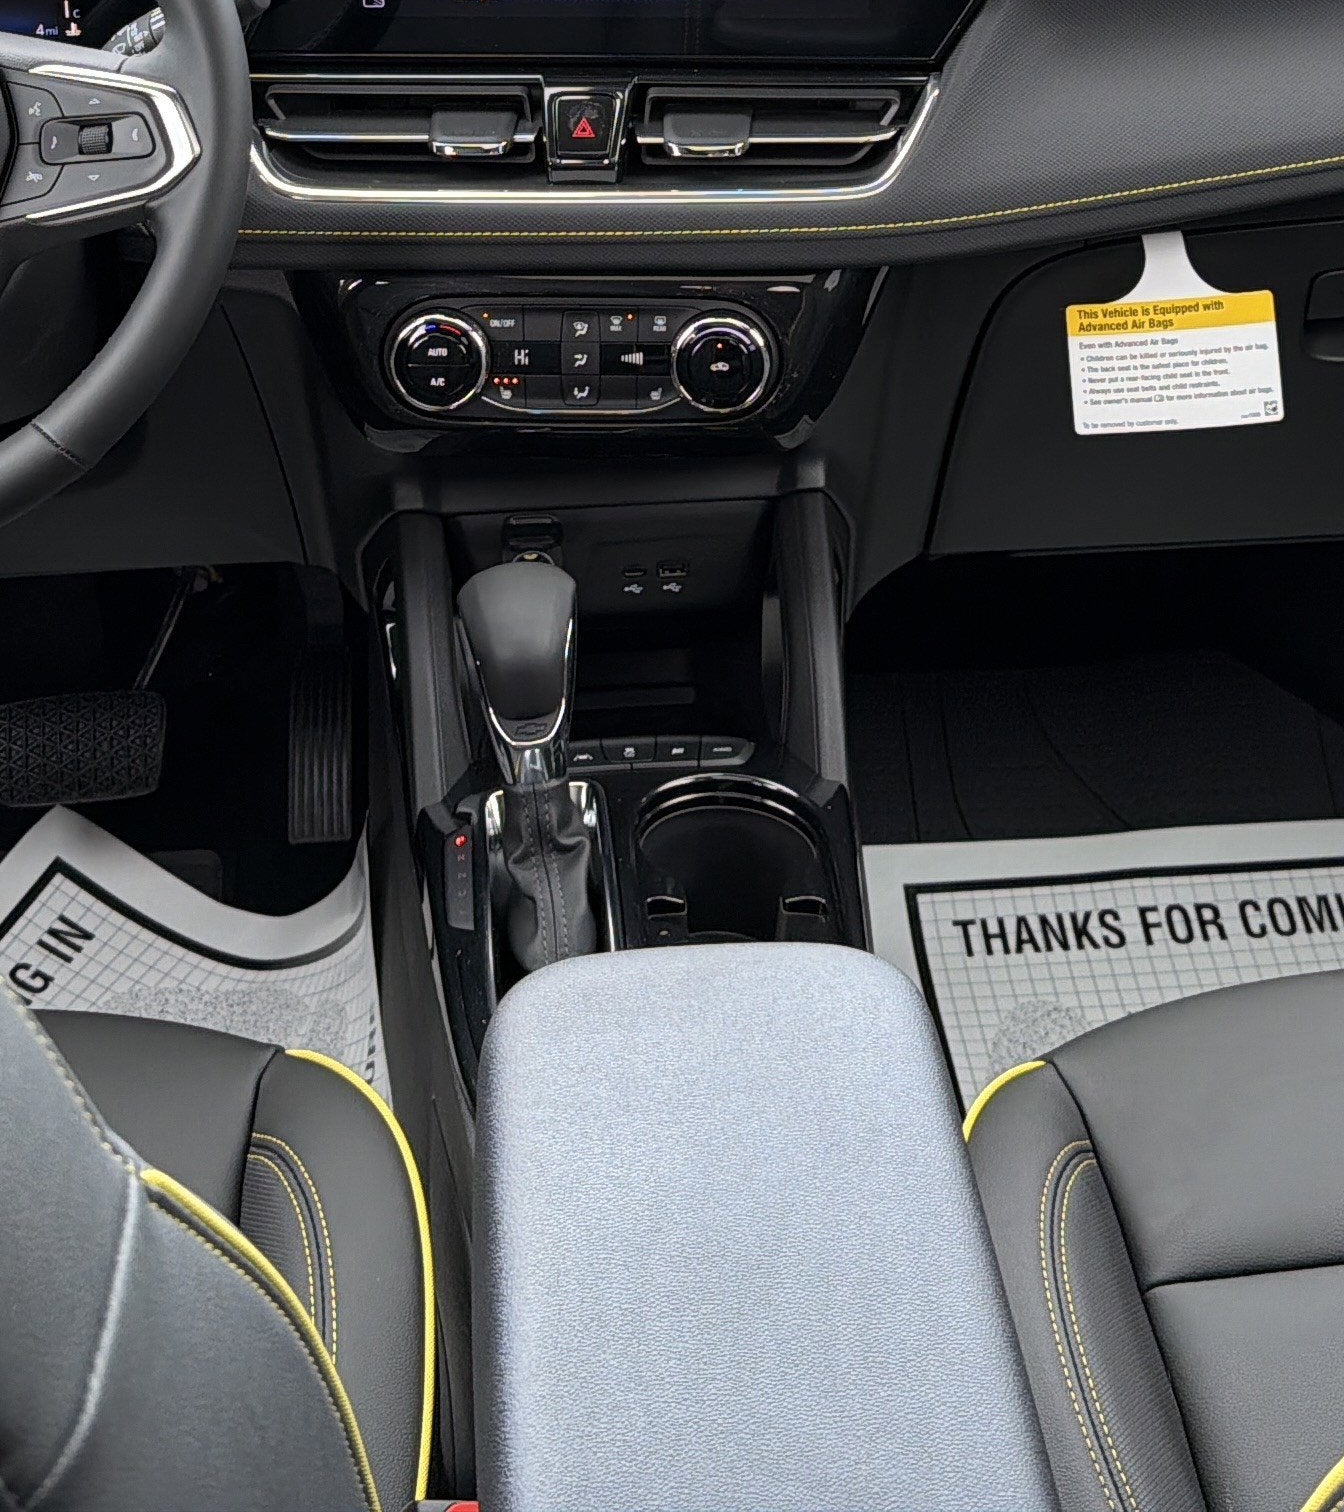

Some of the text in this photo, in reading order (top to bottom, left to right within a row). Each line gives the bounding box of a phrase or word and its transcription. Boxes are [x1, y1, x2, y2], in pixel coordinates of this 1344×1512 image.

[73, 9, 81, 18] C
[36, 23, 59, 36] 4 mi
[1077, 300, 1224, 320] This Vehicle is Equipped with
[489, 319, 515, 327] ON/OFF
[1078, 318, 1174, 332] Advanced Air Bags
[1079, 342, 1096, 350] Even
[1114, 339, 1148, 347] Advanced
[427, 348, 448, 357] AUTO
[514, 349, 529, 365] Hi
[430, 378, 446, 386] A/C
[952, 909, 1127, 959] THANKS
[1139, 899, 1228, 948] FOR
[36, 915, 96, 964] IN
